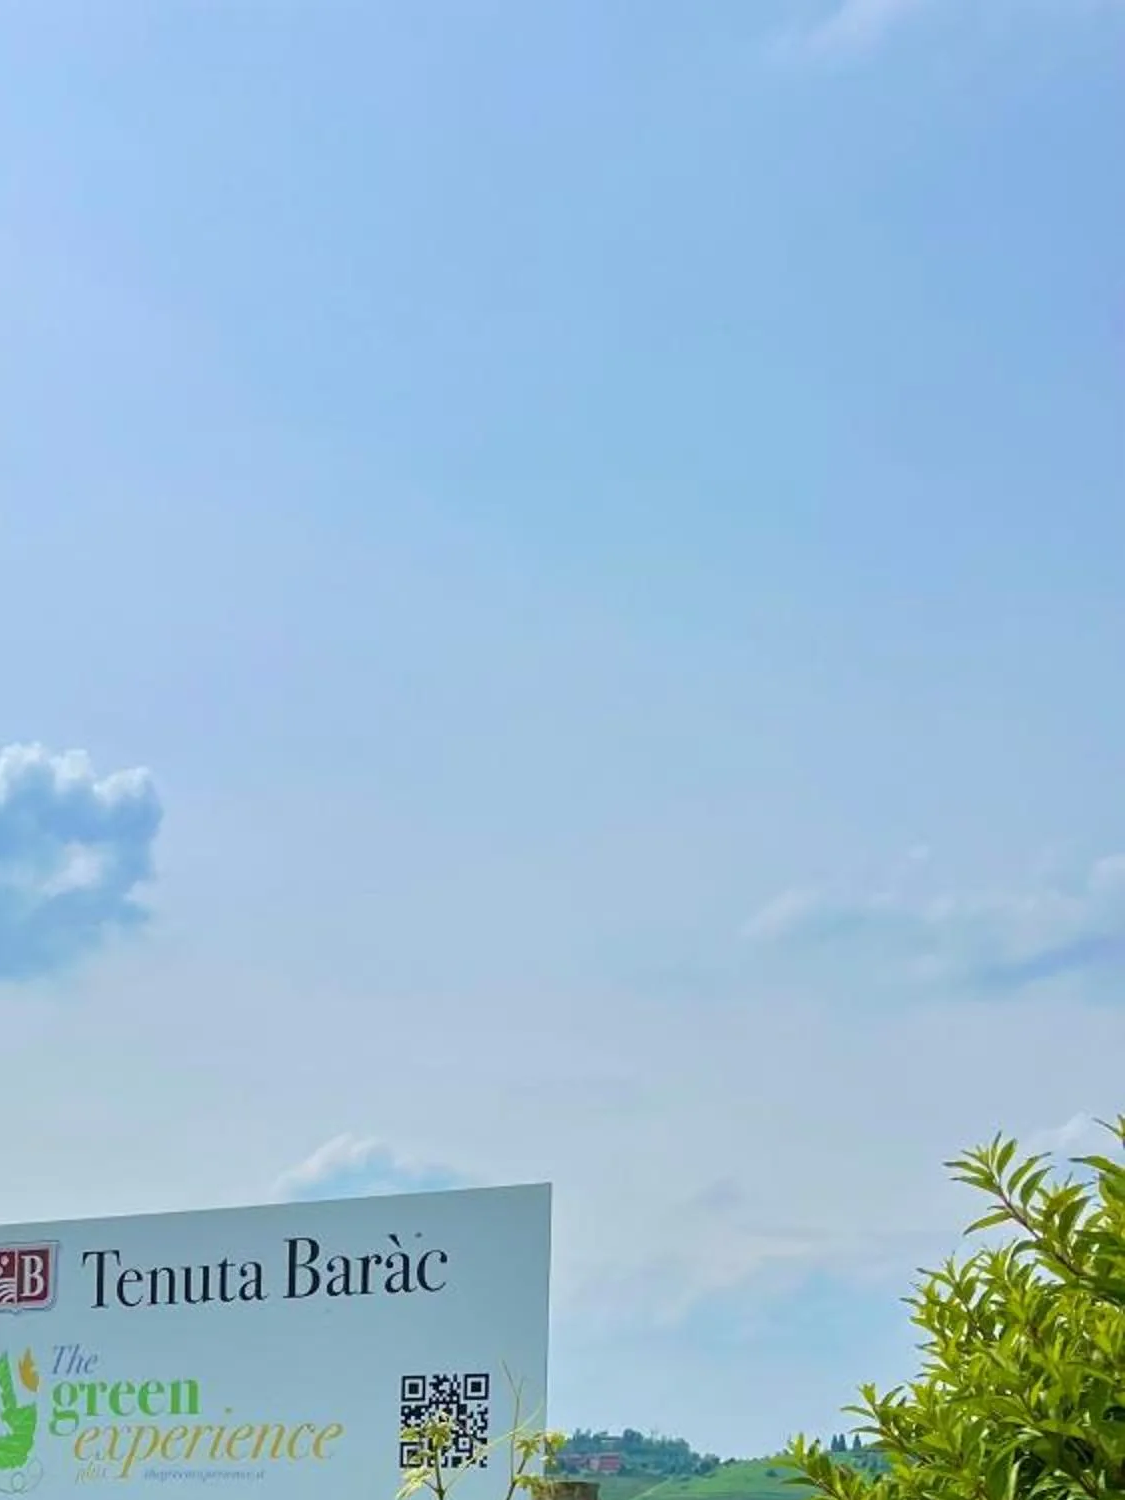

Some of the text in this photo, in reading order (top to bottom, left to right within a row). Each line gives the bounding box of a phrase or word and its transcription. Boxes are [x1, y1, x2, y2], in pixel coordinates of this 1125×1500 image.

[20, 1254, 46, 1298] B
[82, 1233, 449, 1309] Tenuta Baràc
[52, 1344, 99, 1375] The
[49, 1378, 201, 1437] green
[74, 1406, 344, 1479] experience
